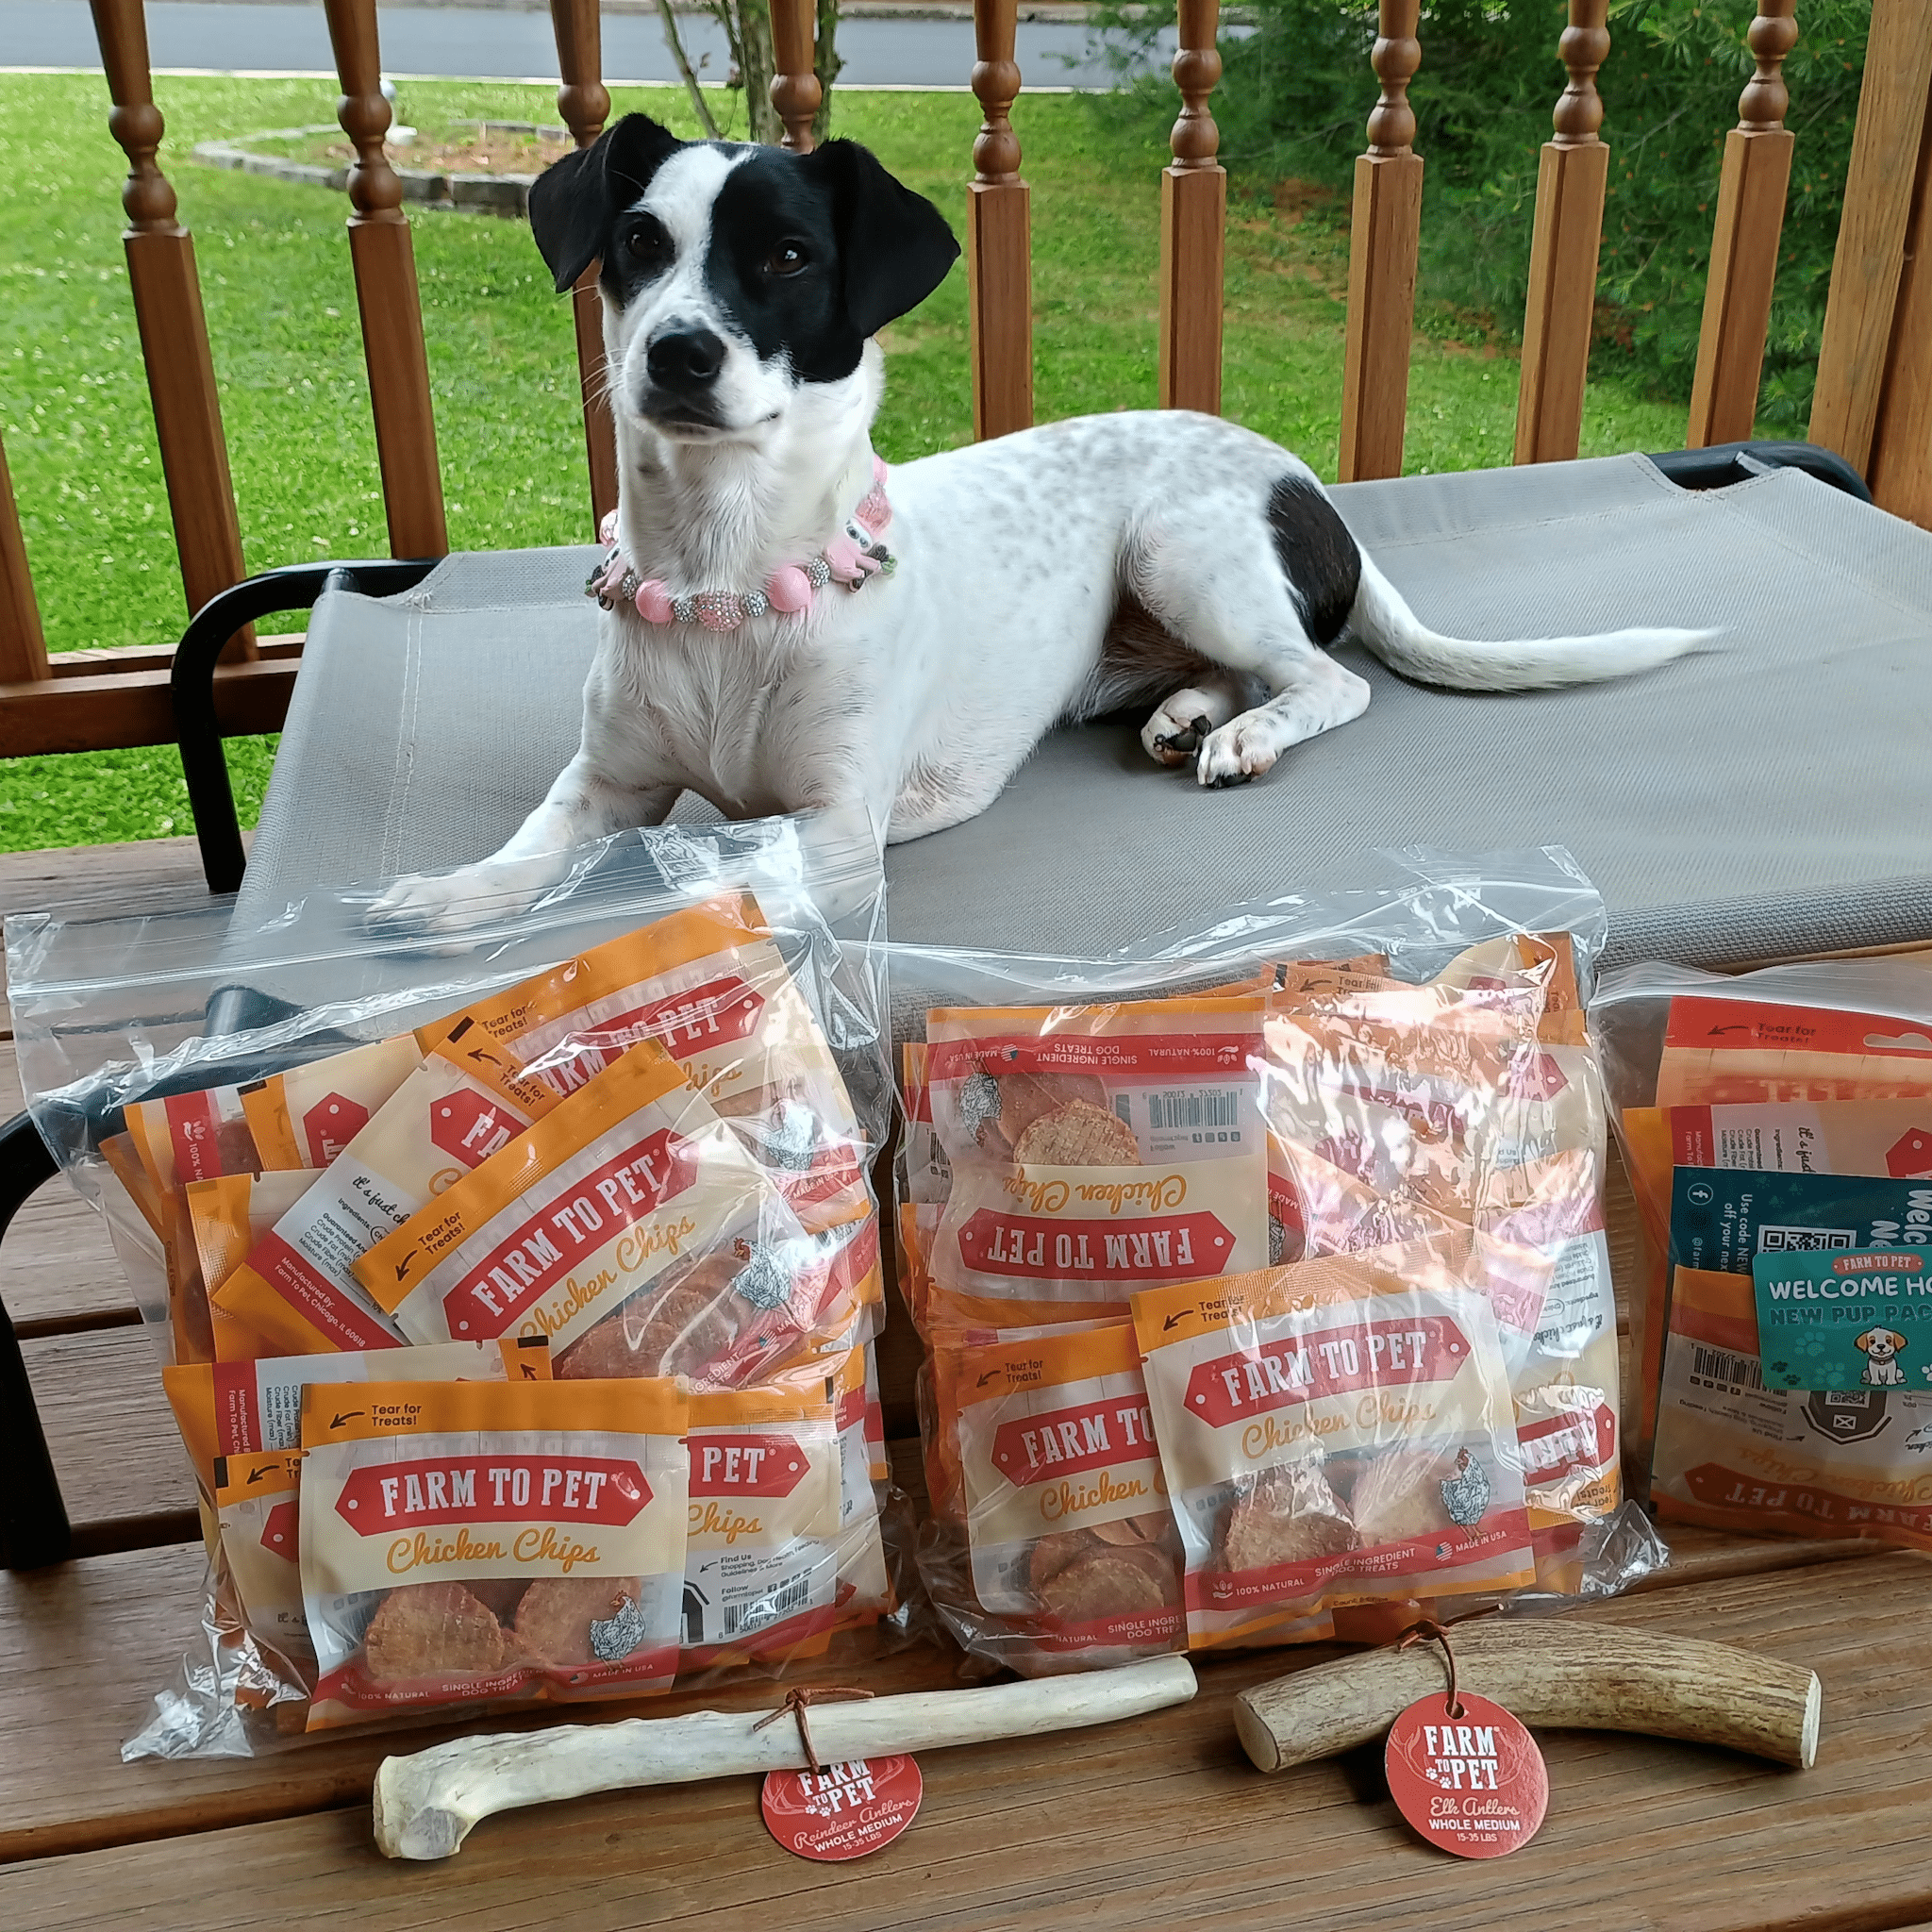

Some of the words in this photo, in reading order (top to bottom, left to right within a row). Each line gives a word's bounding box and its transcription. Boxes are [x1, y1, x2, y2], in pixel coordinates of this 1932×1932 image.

[511, 1005, 528, 1020] for
[657, 996, 722, 1048] PET
[1794, 1025, 1817, 1037] for
[948, 1054, 964, 1063] USA
[974, 1048, 999, 1059] MADE
[1036, 1052, 1100, 1066] INGREDIENT
[1054, 1043, 1090, 1054] TREATS
[1091, 1044, 1121, 1055] DOG
[1101, 1054, 1139, 1066] SINGLE
[1148, 1046, 1187, 1058] NATURAL
[1189, 1047, 1215, 1058] 100%
[528, 1083, 546, 1102] for
[1721, 1130, 1729, 1158] Moisture
[1755, 1128, 1764, 1169] Guaranteed
[792, 1183, 816, 1200] MADE
[1003, 1167, 1071, 1213] Chips
[1074, 1174, 1188, 1215] Chicken
[1273, 1191, 1299, 1210] MADE
[338, 1198, 373, 1230] Ingredients:
[1724, 1202, 1737, 1220] off
[1740, 1193, 1753, 1214] Use
[310, 1225, 329, 1243] Crude
[327, 1239, 340, 1253] Fat
[316, 1219, 335, 1236] Crude
[333, 1233, 356, 1255] Protein
[323, 1212, 358, 1245] Guaranteed
[418, 1223, 446, 1246] Tear
[443, 1211, 462, 1229] for
[424, 1224, 466, 1256] Treats!
[471, 1227, 564, 1318] FARM
[551, 1196, 604, 1244] TO
[594, 1153, 662, 1217] PET
[1720, 1221, 1732, 1248] your
[1739, 1217, 1752, 1244] code
[304, 1231, 323, 1248] Crude
[321, 1245, 338, 1262] Fiber
[616, 1215, 696, 1274] Chips
[988, 1225, 1046, 1266] PET
[1054, 1232, 1094, 1269] TO
[1105, 1227, 1196, 1269] FARM
[298, 1238, 324, 1261] Moisture
[321, 1257, 341, 1277] (max)
[1842, 1256, 1873, 1272] FARM
[1874, 1256, 1889, 1267] TO
[1890, 1255, 1912, 1269] PET
[281, 1257, 328, 1300] Manufactured
[1769, 1275, 1899, 1301] WELCOME
[275, 1264, 293, 1284] Farm
[291, 1279, 302, 1291] To
[298, 1287, 311, 1303] Pet,
[310, 1298, 340, 1327] Chicago,
[344, 1327, 366, 1347] 60618
[1198, 1300, 1226, 1311] Tear
[1769, 1307, 1824, 1325] NEW
[1831, 1305, 1876, 1324] PUP
[1006, 1362, 1027, 1372] Tear
[1028, 1358, 1043, 1370] for
[1007, 1370, 1042, 1383] Treats!
[1221, 1346, 1313, 1407] FARM
[1320, 1339, 1359, 1379] TO
[1365, 1331, 1427, 1371] PET
[228, 1390, 237, 1413] Farm
[265, 1387, 275, 1419] Moisture
[372, 1405, 400, 1416] Tear
[404, 1403, 422, 1414] for
[229, 1413, 238, 1424] To
[238, 1389, 251, 1448] Manufactured
[275, 1409, 284, 1428] Fiber
[283, 1409, 291, 1423] Fat
[372, 1415, 417, 1426] Treats!
[1241, 1404, 1351, 1459] Chicken
[1356, 1395, 1437, 1434] Chips
[267, 1419, 277, 1441] (max)
[286, 1423, 295, 1442] (min)
[1021, 1414, 1111, 1469] FARM
[702, 1446, 766, 1484] PET
[380, 1469, 476, 1517] FARM
[489, 1468, 530, 1507] TO
[541, 1469, 607, 1509] PET
[1040, 1471, 1149, 1523] Chicken
[1724, 1482, 1790, 1508] PET
[387, 1527, 508, 1574] Chicken
[513, 1526, 601, 1574] Chips
[1456, 1539, 1479, 1553] MADE
[1491, 1530, 1507, 1542] USA
[721, 1556, 739, 1564] Find
[721, 1560, 756, 1573] Shopping,
[721, 1567, 758, 1578] Guidelines
[765, 1561, 783, 1570] More
[1314, 1558, 1353, 1577] SINGLE
[1352, 1547, 1416, 1566] INGREDIENT
[1358, 1560, 1399, 1574] TREATS
[721, 1584, 749, 1594] Follow
[1236, 1585, 1260, 1596] 100%
[1261, 1577, 1306, 1592] NATURAL
[1108, 1620, 1145, 1634] SINGLE
[1126, 1628, 1153, 1640] DOG
[633, 1663, 654, 1674] USA
[1424, 1725, 1498, 1757] FARM
[797, 1758, 872, 1797] FARM
[1435, 1758, 1450, 1774] TO
[1451, 1758, 1498, 1790] PET
[812, 1791, 829, 1807] TO
[826, 1775, 876, 1813] PET
[1430, 1796, 1460, 1817] Elk
[1462, 1796, 1521, 1817] Antlers
[793, 1819, 858, 1850] Reindeer
[858, 1798, 915, 1824] Antlers
[813, 1830, 857, 1853] WHOLE
[858, 1813, 903, 1837] MEDIUM
[1428, 1819, 1472, 1830] WHOLE
[1474, 1819, 1521, 1831] MEDIUM
[841, 1838, 865, 1852] 15-35
[866, 1831, 883, 1843] LBS
[1456, 1833, 1479, 1842] 15-35
[1480, 1833, 1497, 1842] LBS
